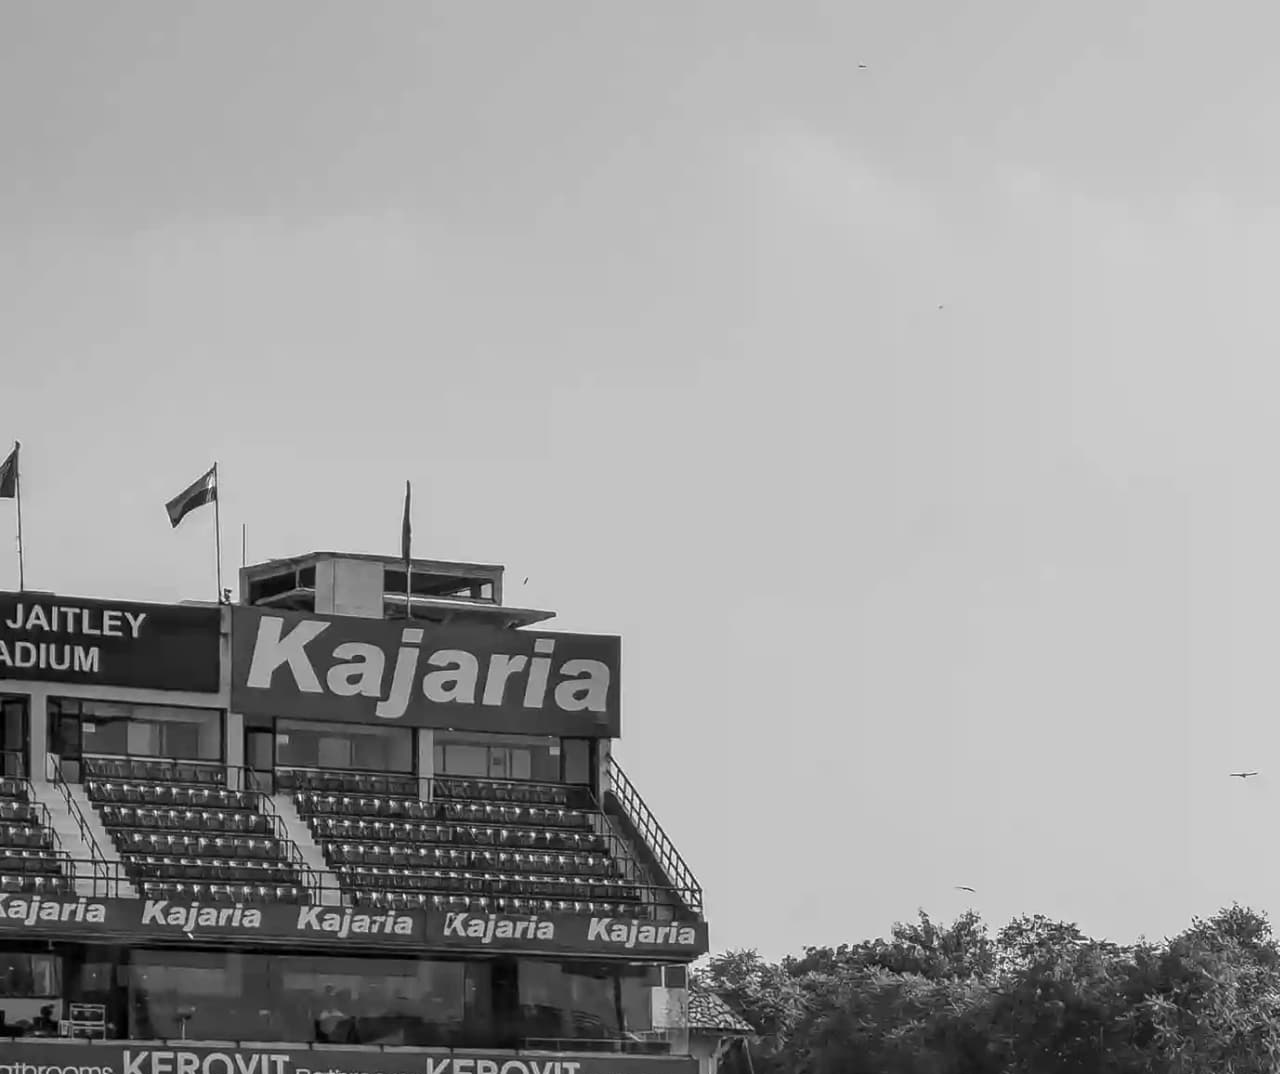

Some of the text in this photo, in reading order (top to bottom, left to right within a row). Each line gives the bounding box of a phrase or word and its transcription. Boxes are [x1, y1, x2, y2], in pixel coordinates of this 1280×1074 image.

[5, 603, 147, 639] JAITLEY
[246, 616, 610, 718] Kajaria
[0, 896, 106, 926] ajaria
[142, 900, 260, 931] Kajaria
[297, 906, 413, 937] Kajaria
[444, 912, 555, 942] Kajaria
[587, 918, 695, 948] Kajaria
